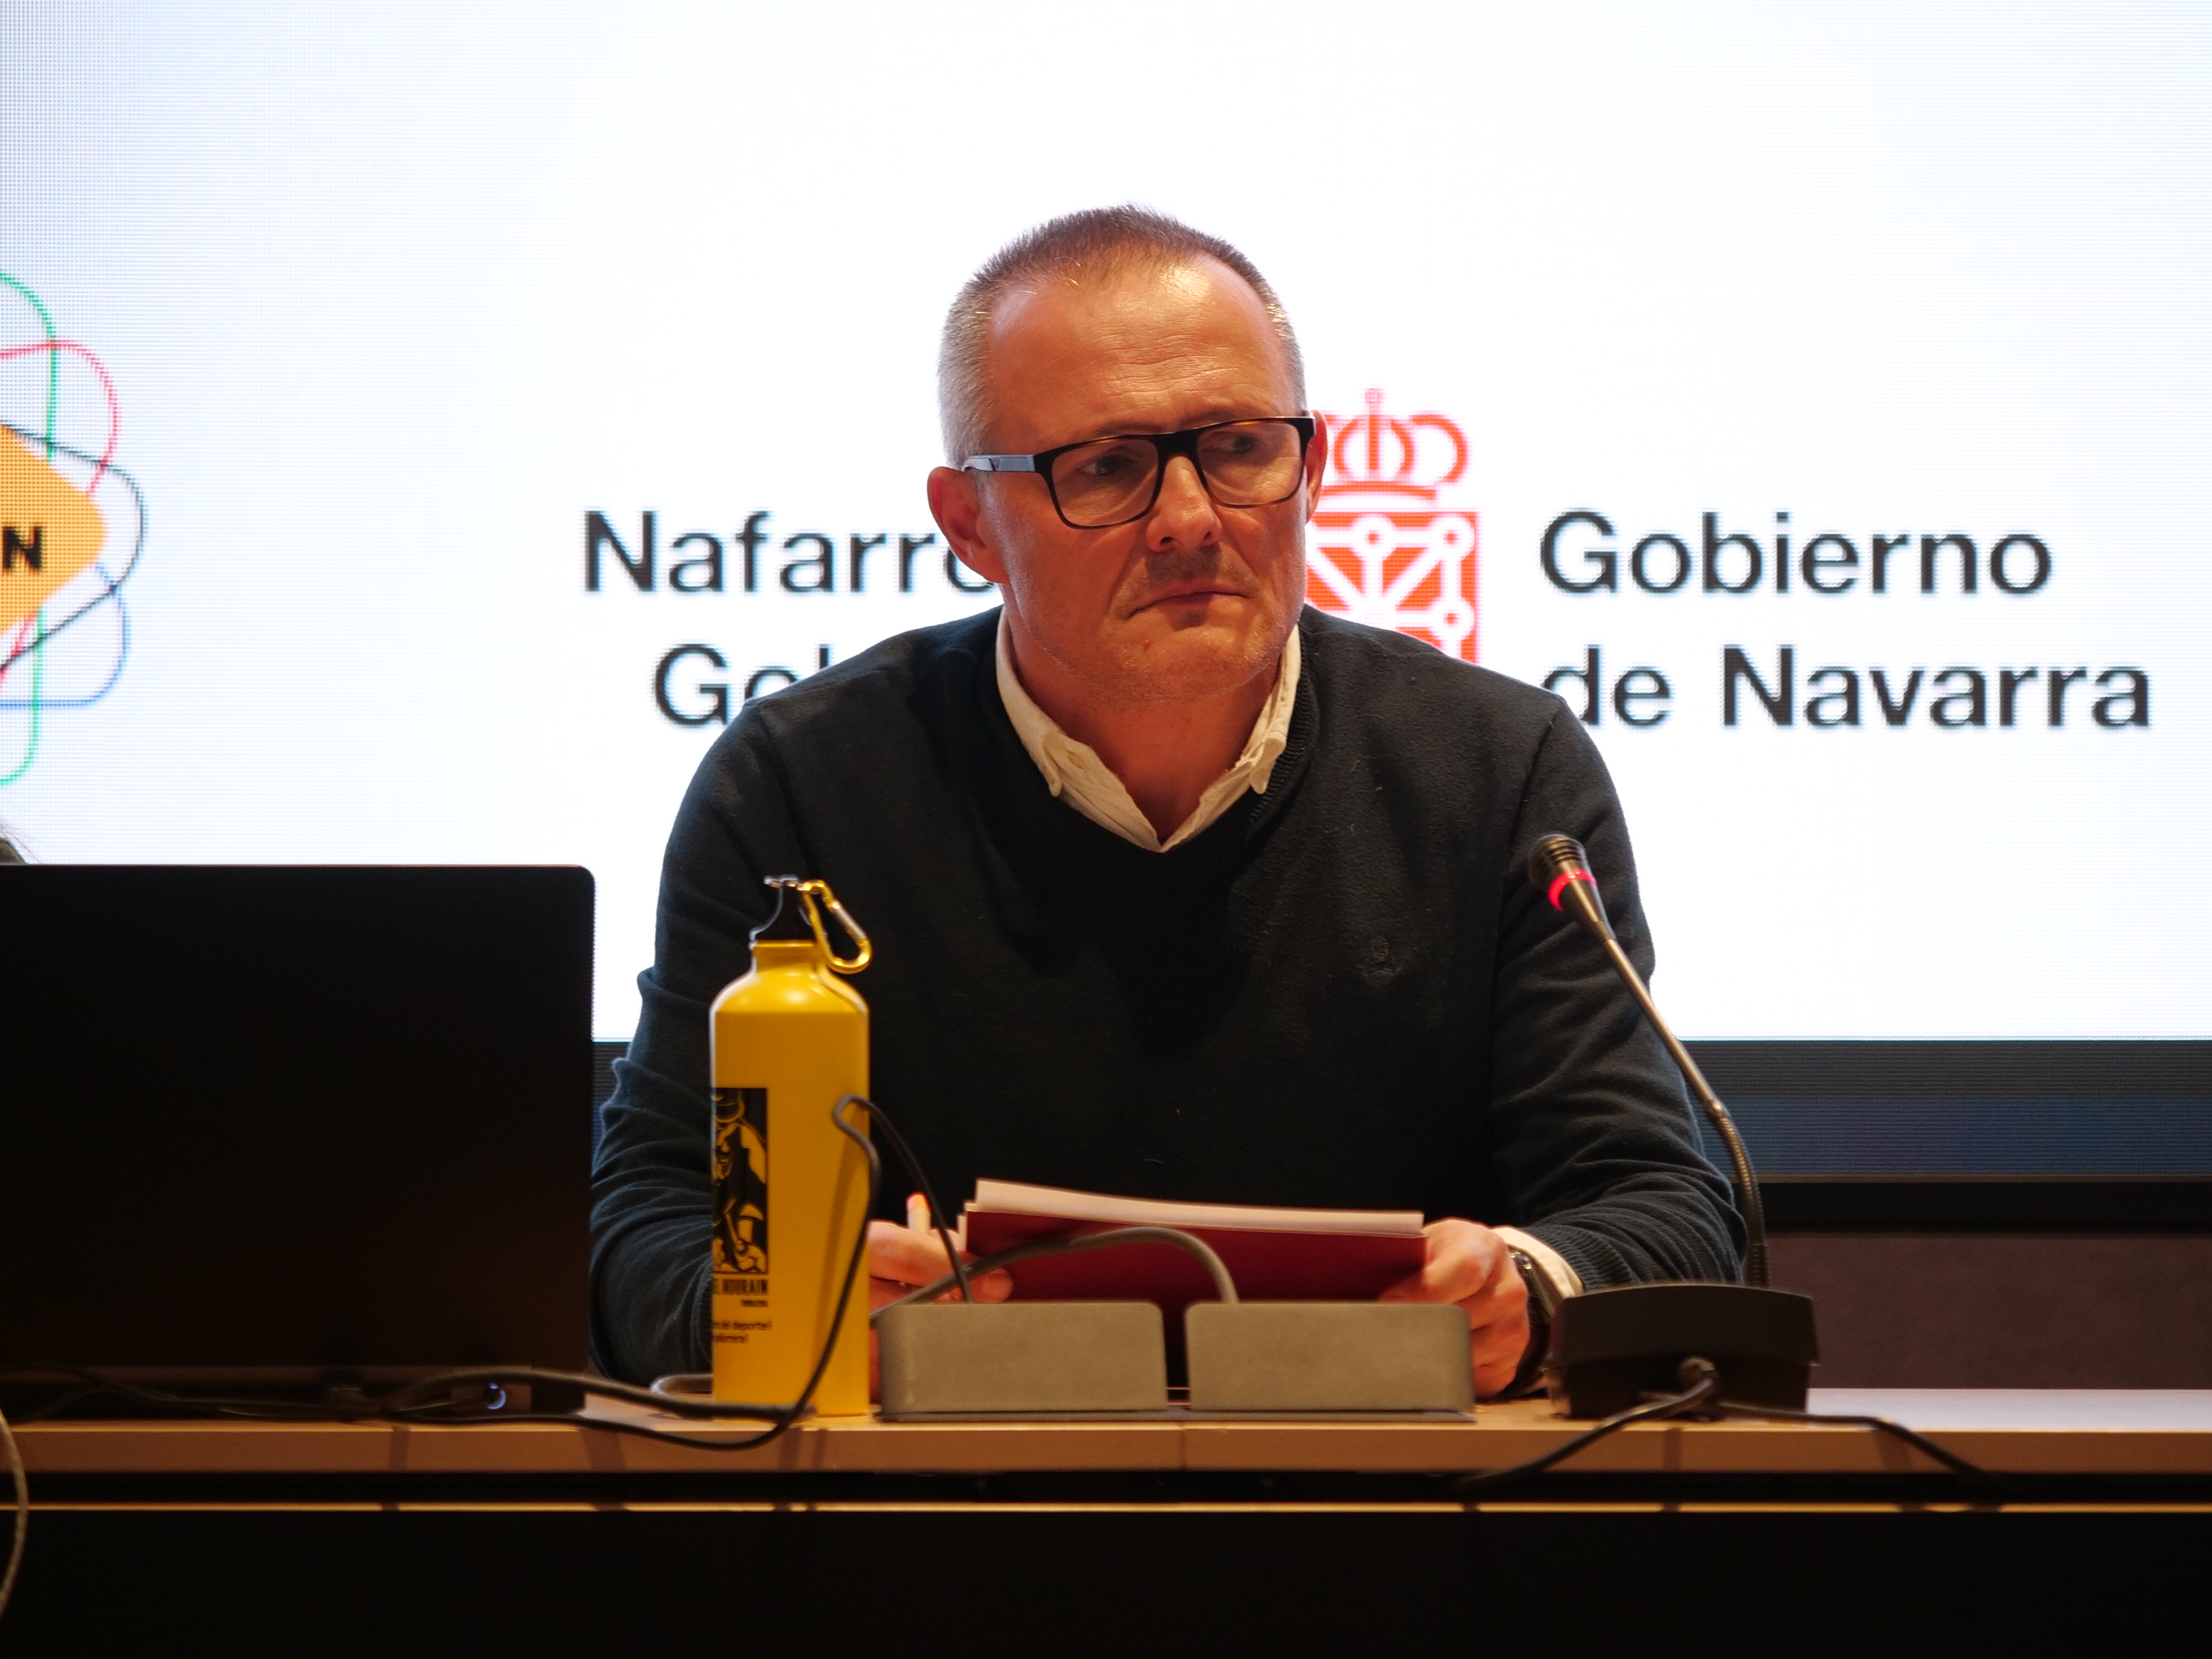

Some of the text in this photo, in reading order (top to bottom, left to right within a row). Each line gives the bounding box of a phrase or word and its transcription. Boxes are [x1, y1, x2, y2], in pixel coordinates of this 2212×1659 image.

[1539, 509, 2052, 594] Gobierno
[1540, 644, 2148, 727] de Navarra
